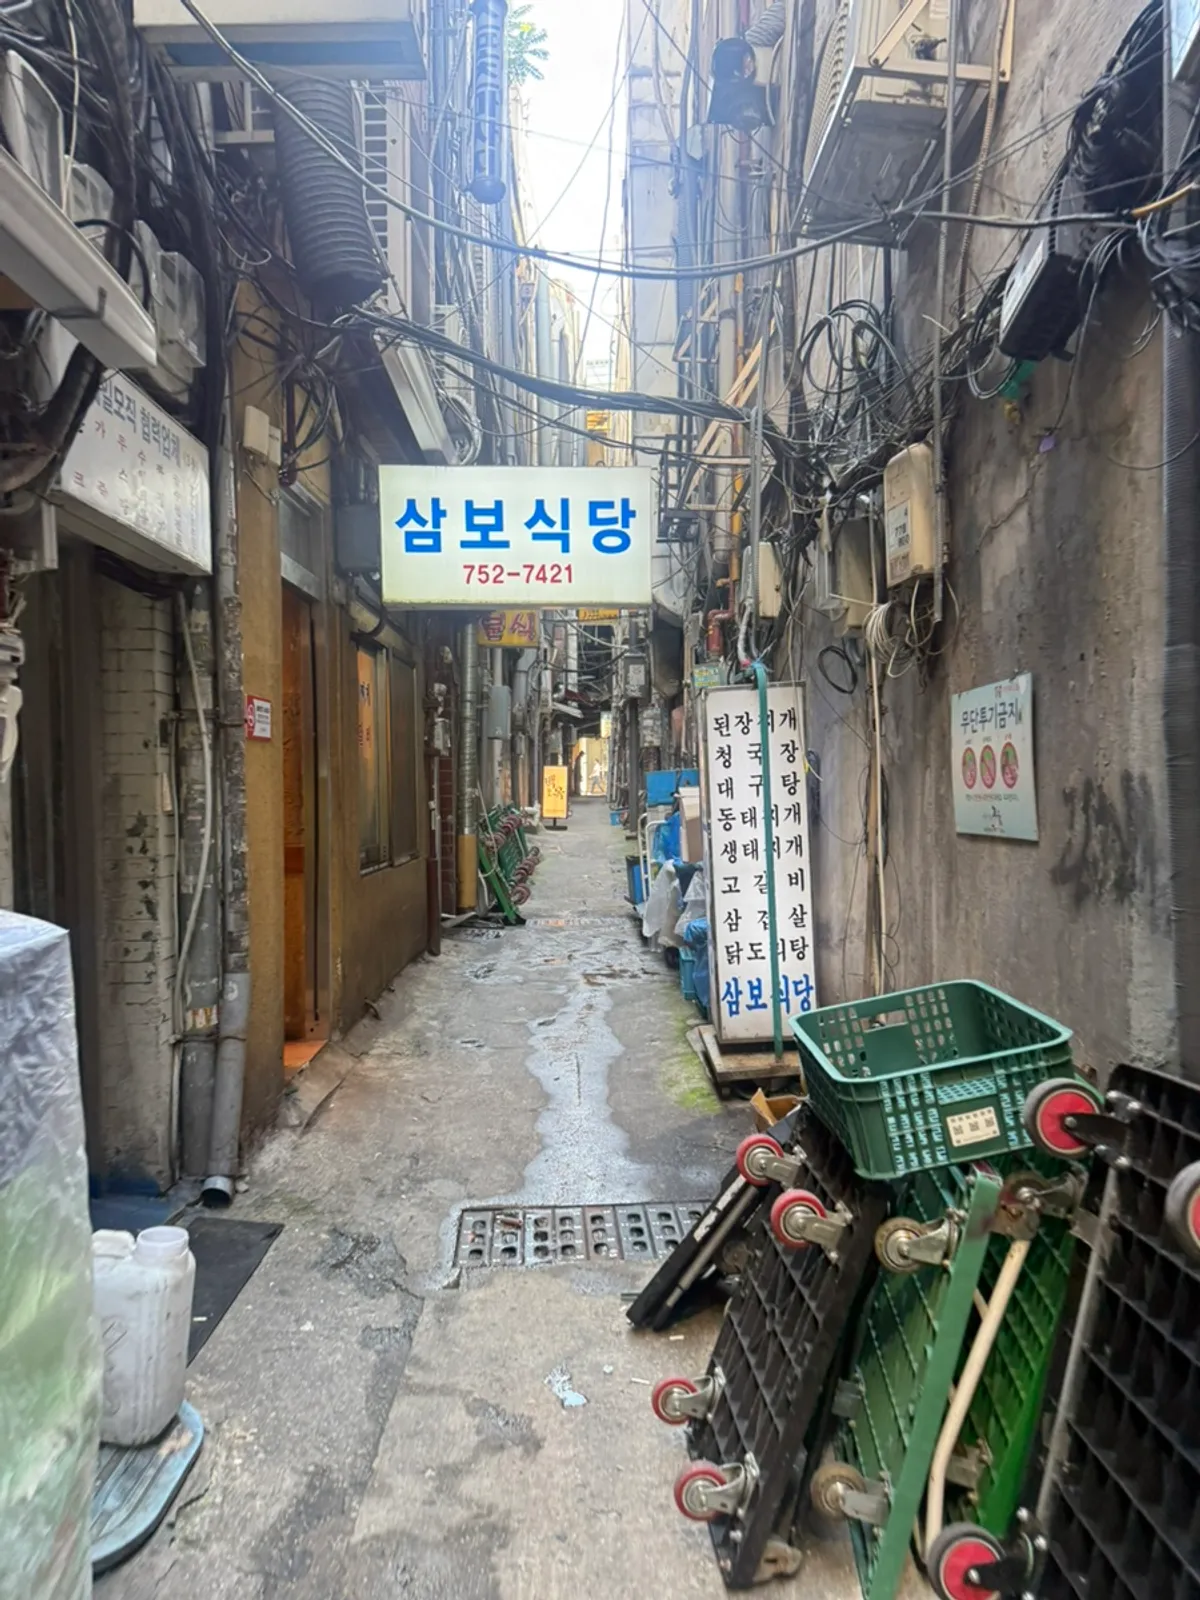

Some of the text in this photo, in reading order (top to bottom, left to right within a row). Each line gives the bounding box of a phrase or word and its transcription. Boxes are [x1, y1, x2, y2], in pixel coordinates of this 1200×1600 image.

[96, 378, 182, 468] 일모직 협력업체
[395, 497, 637, 554] 삼보식당
[463, 563, 574, 585] 752-7421
[715, 739, 799, 769] 청국장
[717, 771, 801, 800] 대구탕
